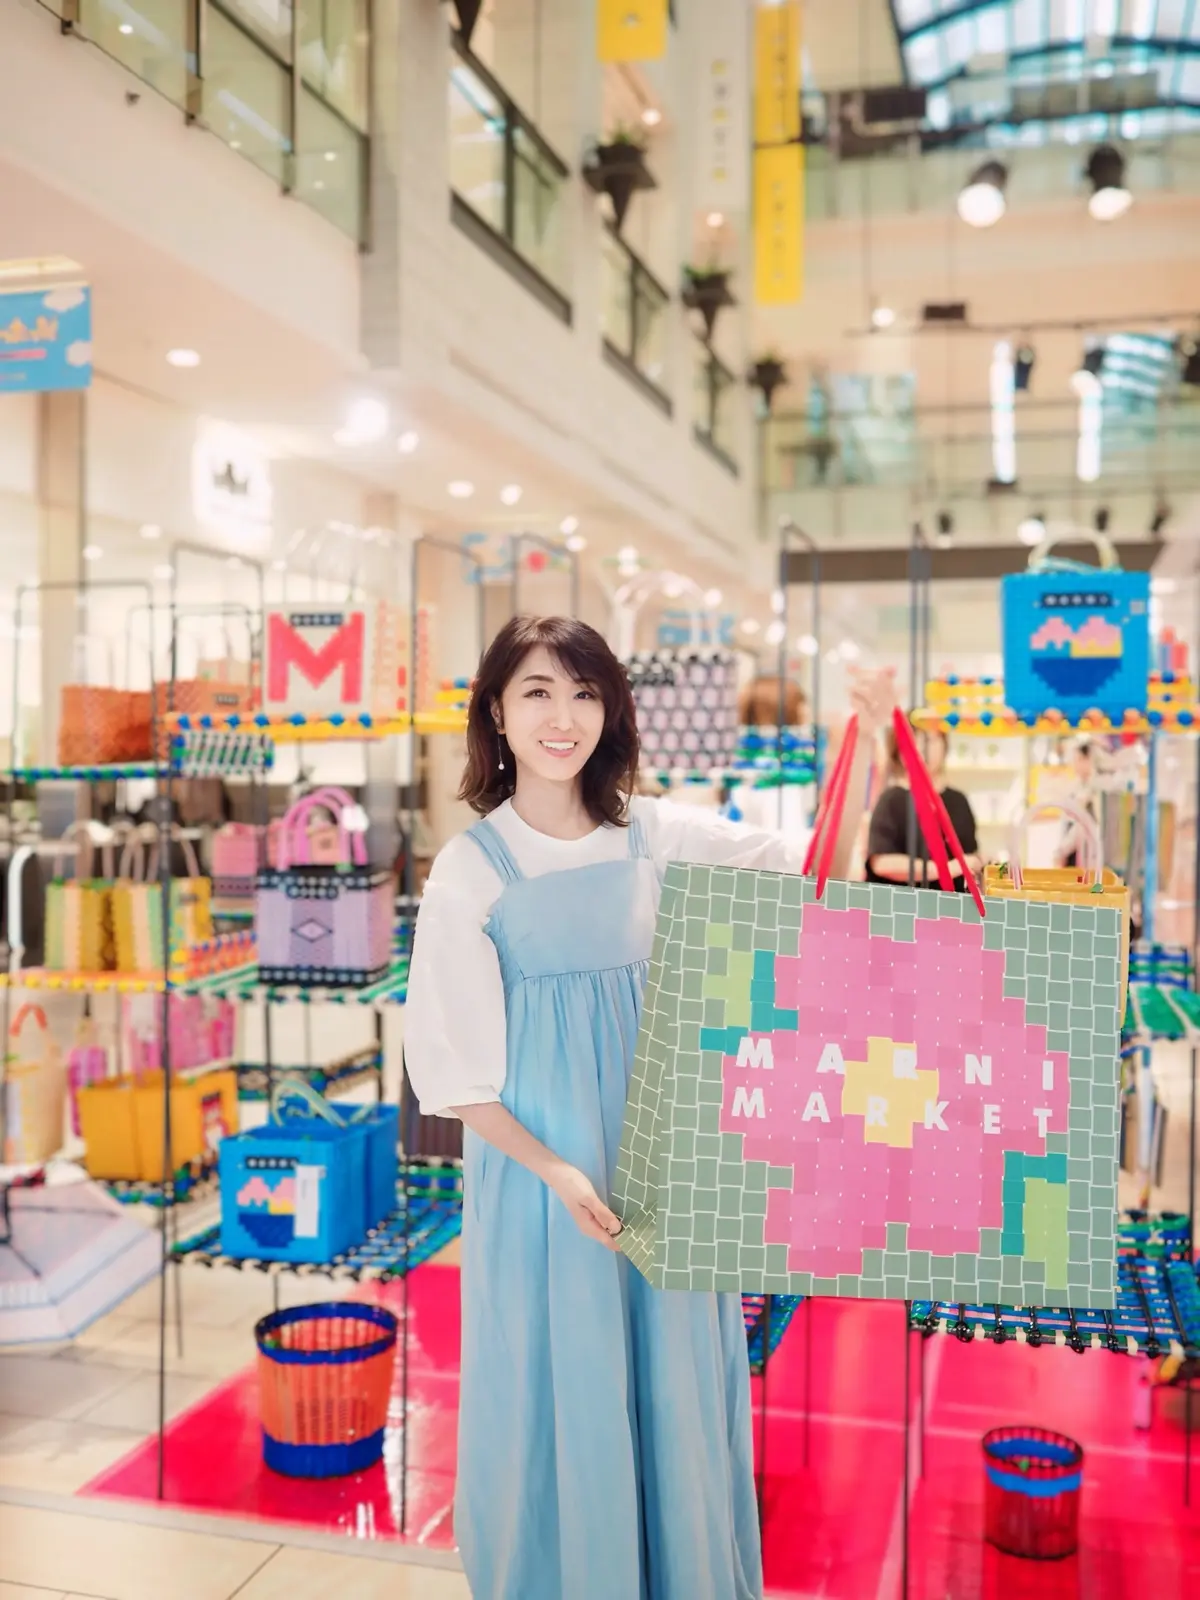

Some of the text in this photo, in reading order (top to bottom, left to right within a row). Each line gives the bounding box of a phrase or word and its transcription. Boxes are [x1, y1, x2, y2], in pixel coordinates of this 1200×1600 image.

[268, 611, 365, 703] M
[736, 1037, 1054, 1091] MARNI
[732, 1087, 1053, 1138] MARKET
